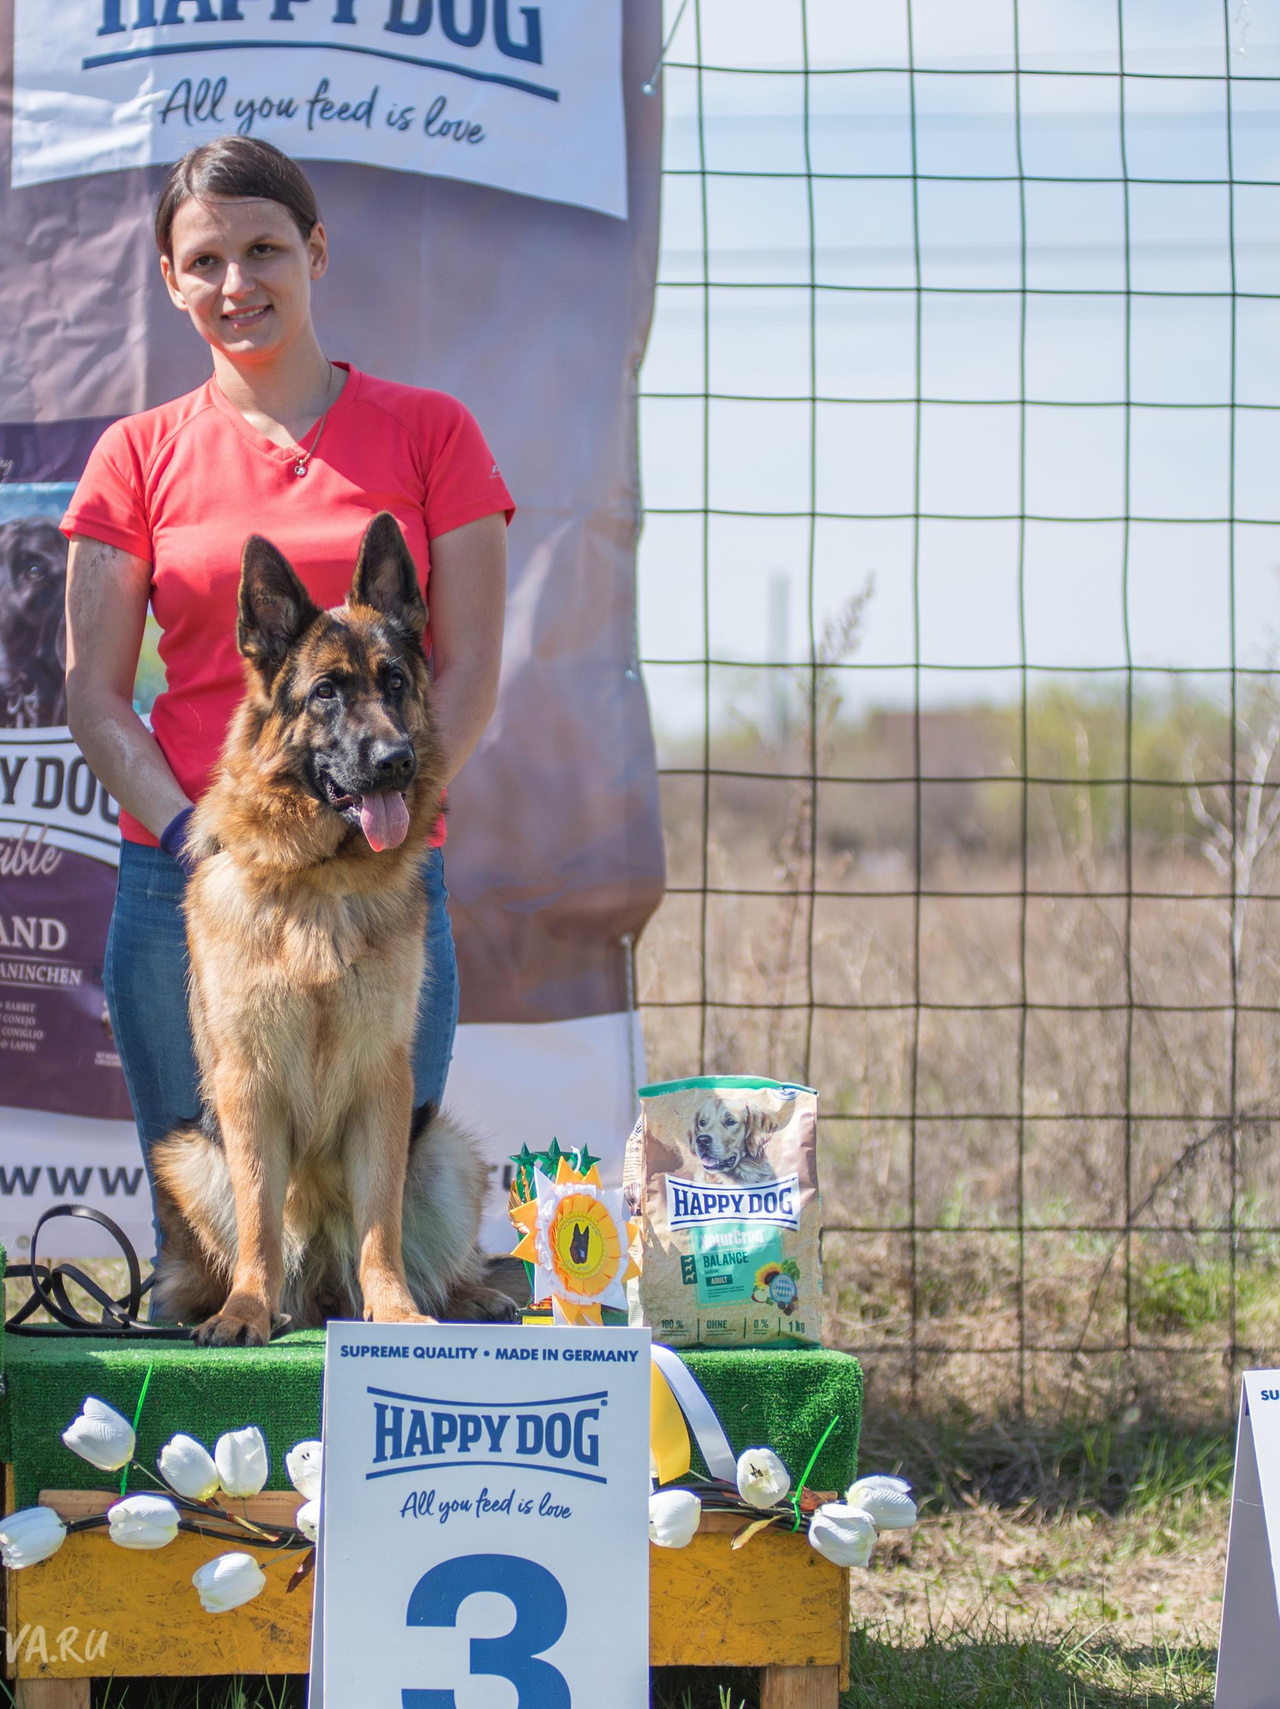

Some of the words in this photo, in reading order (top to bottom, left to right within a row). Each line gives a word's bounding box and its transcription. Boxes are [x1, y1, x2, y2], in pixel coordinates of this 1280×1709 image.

[158, 76, 228, 127] All
[235, 97, 298, 134] you
[307, 77, 379, 131] feed
[387, 101, 414, 131] is
[425, 96, 487, 146] love
[5, 1001, 35, 1013] RABBIT
[3, 1014, 35, 1027] CONEJO
[2, 1027, 43, 1040] CONIGLIO
[672, 1187, 744, 1217] HAPPY
[748, 1187, 794, 1217] DOG
[703, 1251, 749, 1268] BALANCE
[710, 1276, 728, 1285] ADULT
[706, 1319, 728, 1329] OHNE
[796, 1320, 805, 1334] kg
[340, 1345, 410, 1359] SUPREME
[413, 1347, 479, 1361] QUALITY
[495, 1348, 539, 1361] MADE
[542, 1349, 559, 1362] IN
[562, 1349, 639, 1363] GERMANY
[373, 1402, 511, 1464] HAPPY
[516, 1408, 600, 1467] DOG
[400, 1490, 436, 1519] All
[438, 1498, 473, 1524] you
[475, 1487, 516, 1518] feed
[518, 1497, 534, 1514] is
[538, 1493, 572, 1519] love
[401, 1553, 572, 1709] 3
